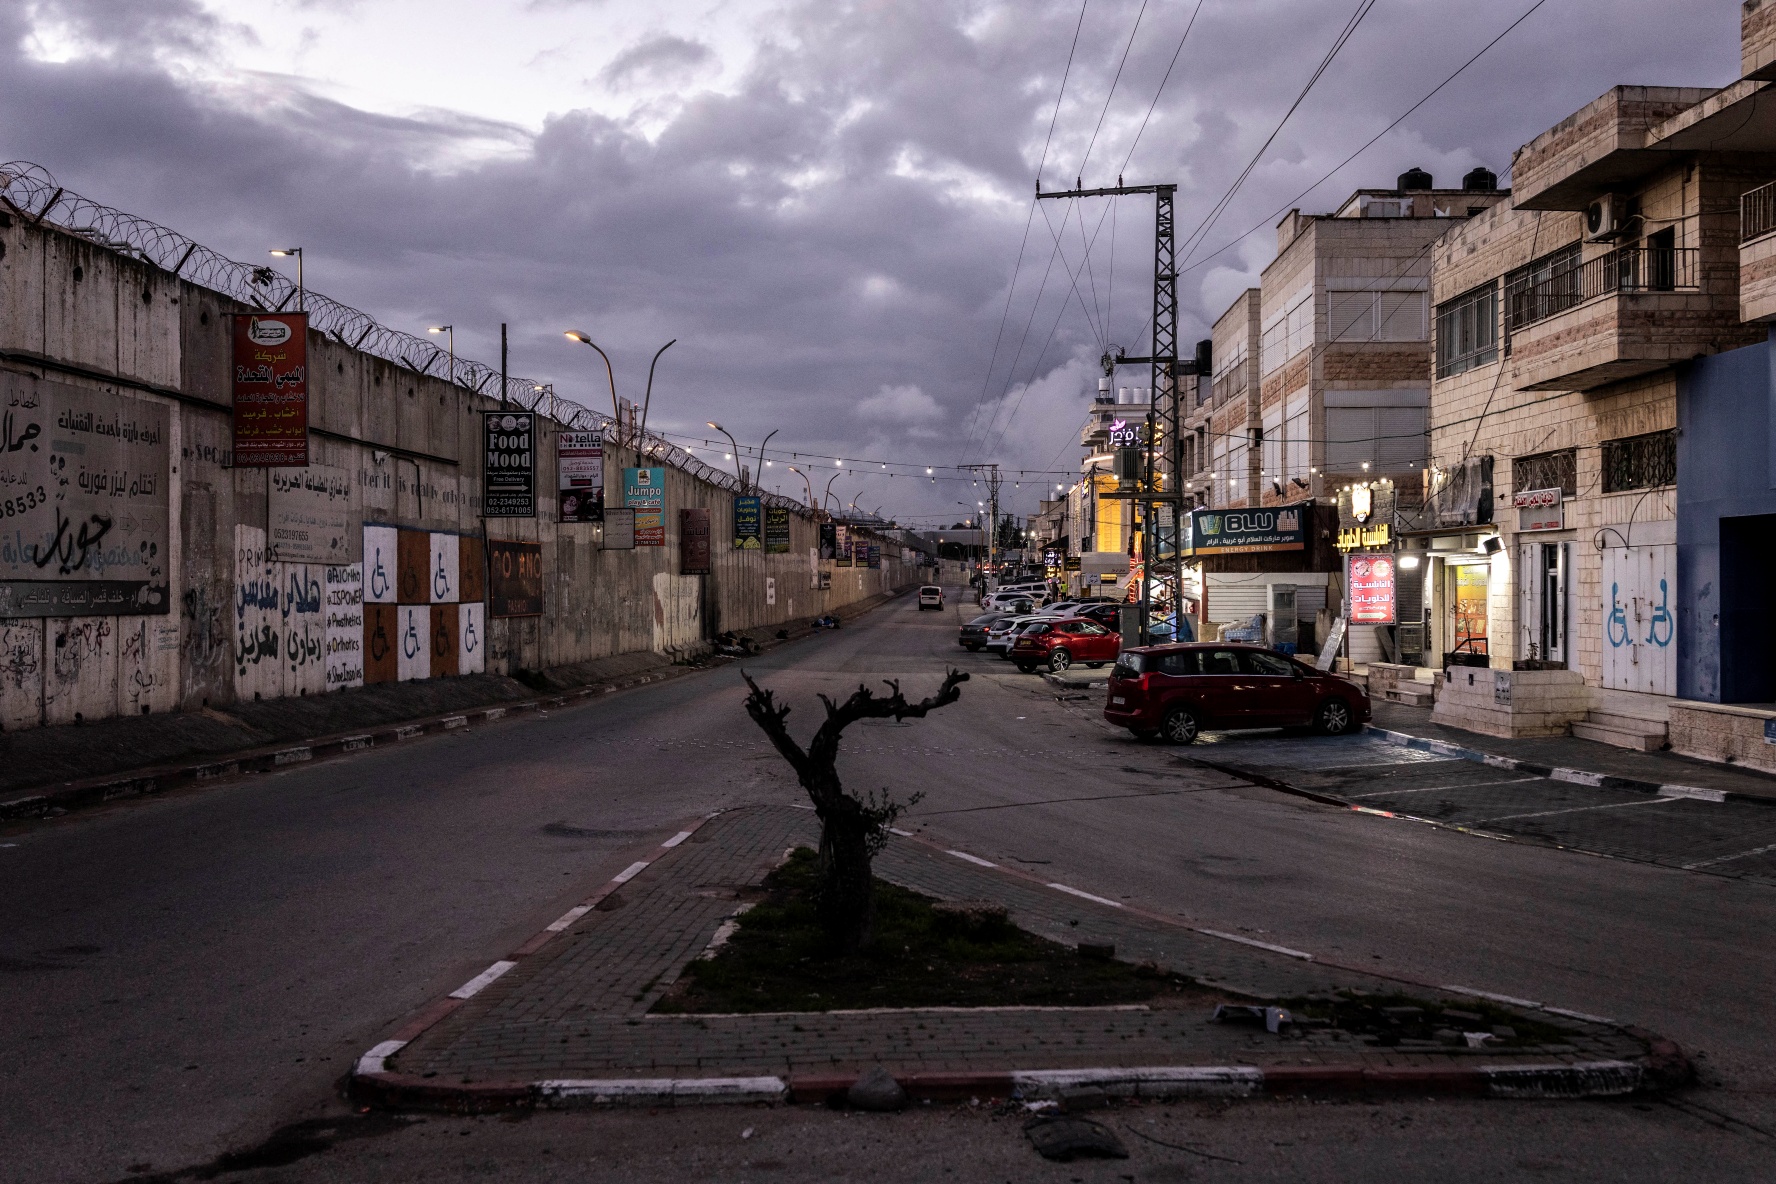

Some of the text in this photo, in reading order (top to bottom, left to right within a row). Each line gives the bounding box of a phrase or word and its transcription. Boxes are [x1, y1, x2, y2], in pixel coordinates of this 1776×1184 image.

[254, 349, 287, 363] شركة
[237, 365, 273, 383] المتحدة
[243, 408, 267, 419] قرميد
[58, 408, 93, 435] التقنيات
[96, 413, 121, 442] بأحدث
[123, 422, 138, 445] بارزة
[237, 423, 259, 436] فرشات
[265, 423, 283, 436] خشب
[489, 433, 529, 449] Food
[487, 451, 531, 467] Mood
[78, 465, 157, 498] أختام ليزر فورية
[305, 470, 327, 497] للطباعة
[383, 472, 390, 489] it
[399, 476, 406, 492] is
[628, 486, 661, 498] Jumpo
[488, 498, 529, 506] 02-2349253
[628, 499, 641, 507] play
[486, 506, 531, 514] 052-6171005
[767, 515, 788, 524] الريان
[1225, 512, 1273, 533] BLU
[1206, 538, 1219, 547] الرام
[1238, 537, 1246, 545] أبو
[1337, 524, 1388, 552] النابلسية للحلويات
[1354, 580, 1390, 590] النابلسية
[1354, 594, 1390, 604] للحلويات
